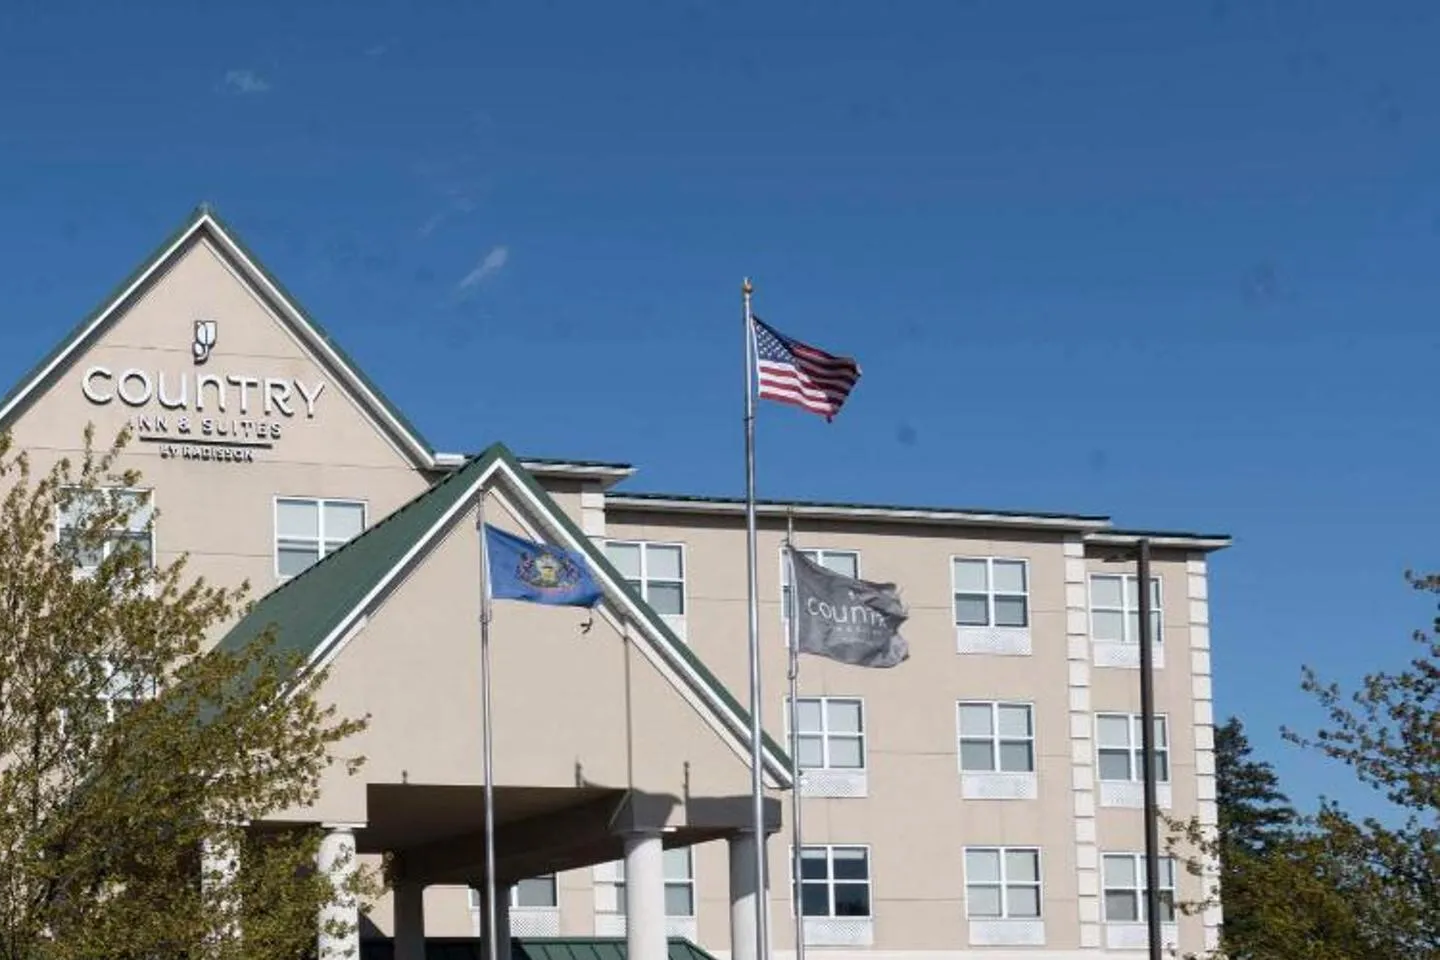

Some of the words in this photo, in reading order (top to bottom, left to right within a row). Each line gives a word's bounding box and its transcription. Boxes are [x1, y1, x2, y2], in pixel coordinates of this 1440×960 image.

[178, 417, 191, 435] &
[201, 419, 281, 440] SUITES
[182, 447, 254, 463] RADISSON
